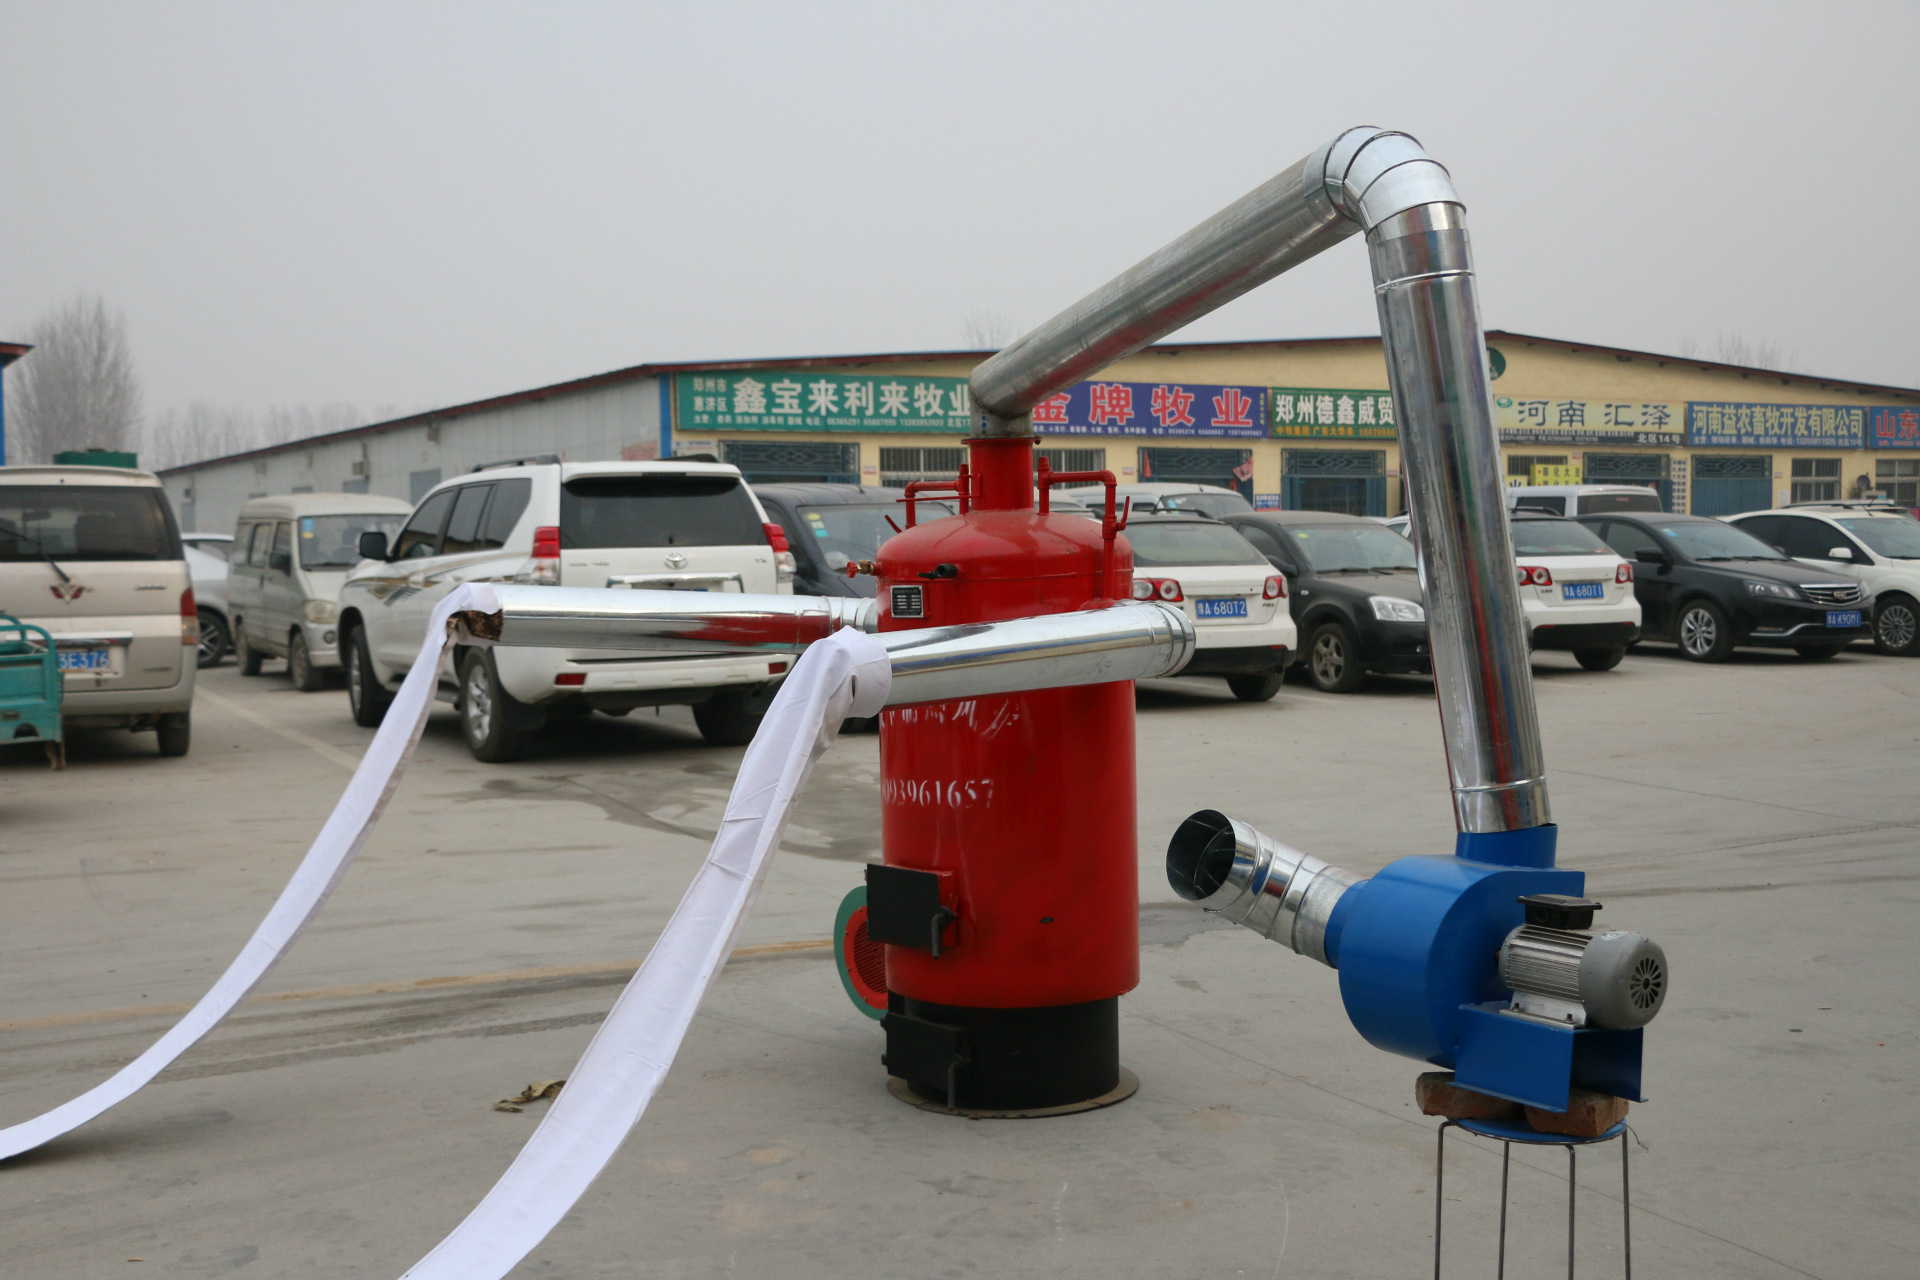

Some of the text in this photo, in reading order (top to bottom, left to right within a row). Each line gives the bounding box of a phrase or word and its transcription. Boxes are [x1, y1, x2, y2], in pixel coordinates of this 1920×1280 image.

[733, 378, 971, 417] 鑫宝来利来牧业
[1033, 383, 1253, 428] 金牌牧业
[1275, 394, 1395, 425] 郑州德鑫威贸
[1517, 400, 1672, 430] 河南汇泽
[1692, 404, 1864, 438] 河南益农畜牧开发有限公司
[1876, 409, 1920, 440] 山东
[1637, 433, 1681, 445] 北区14号
